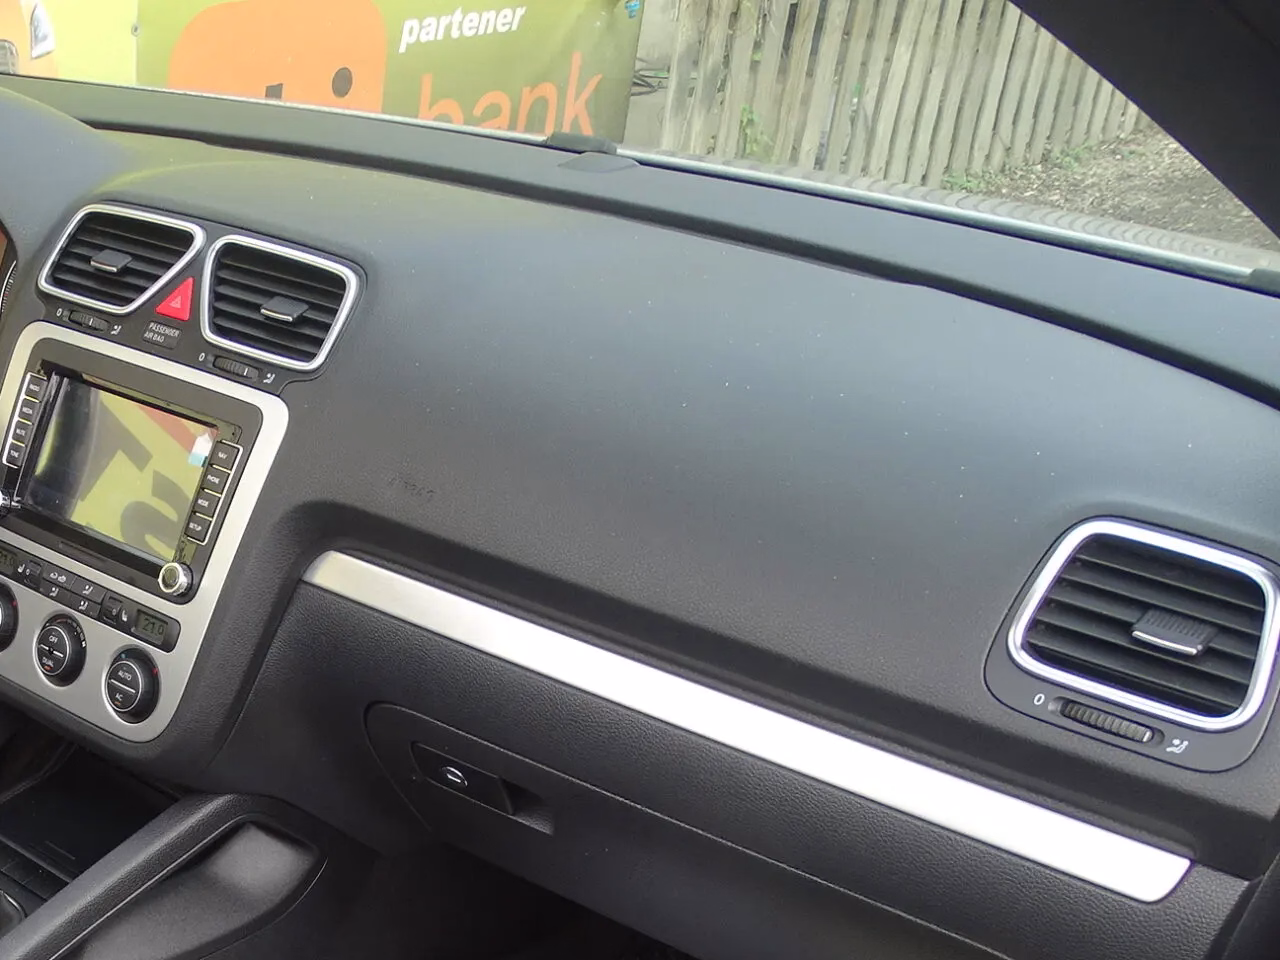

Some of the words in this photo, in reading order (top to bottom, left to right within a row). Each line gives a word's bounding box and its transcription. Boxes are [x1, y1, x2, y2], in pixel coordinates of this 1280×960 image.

[399, 6, 526, 54] partener
[418, 51, 603, 137] bank
[1033, 693, 1045, 705] 0
